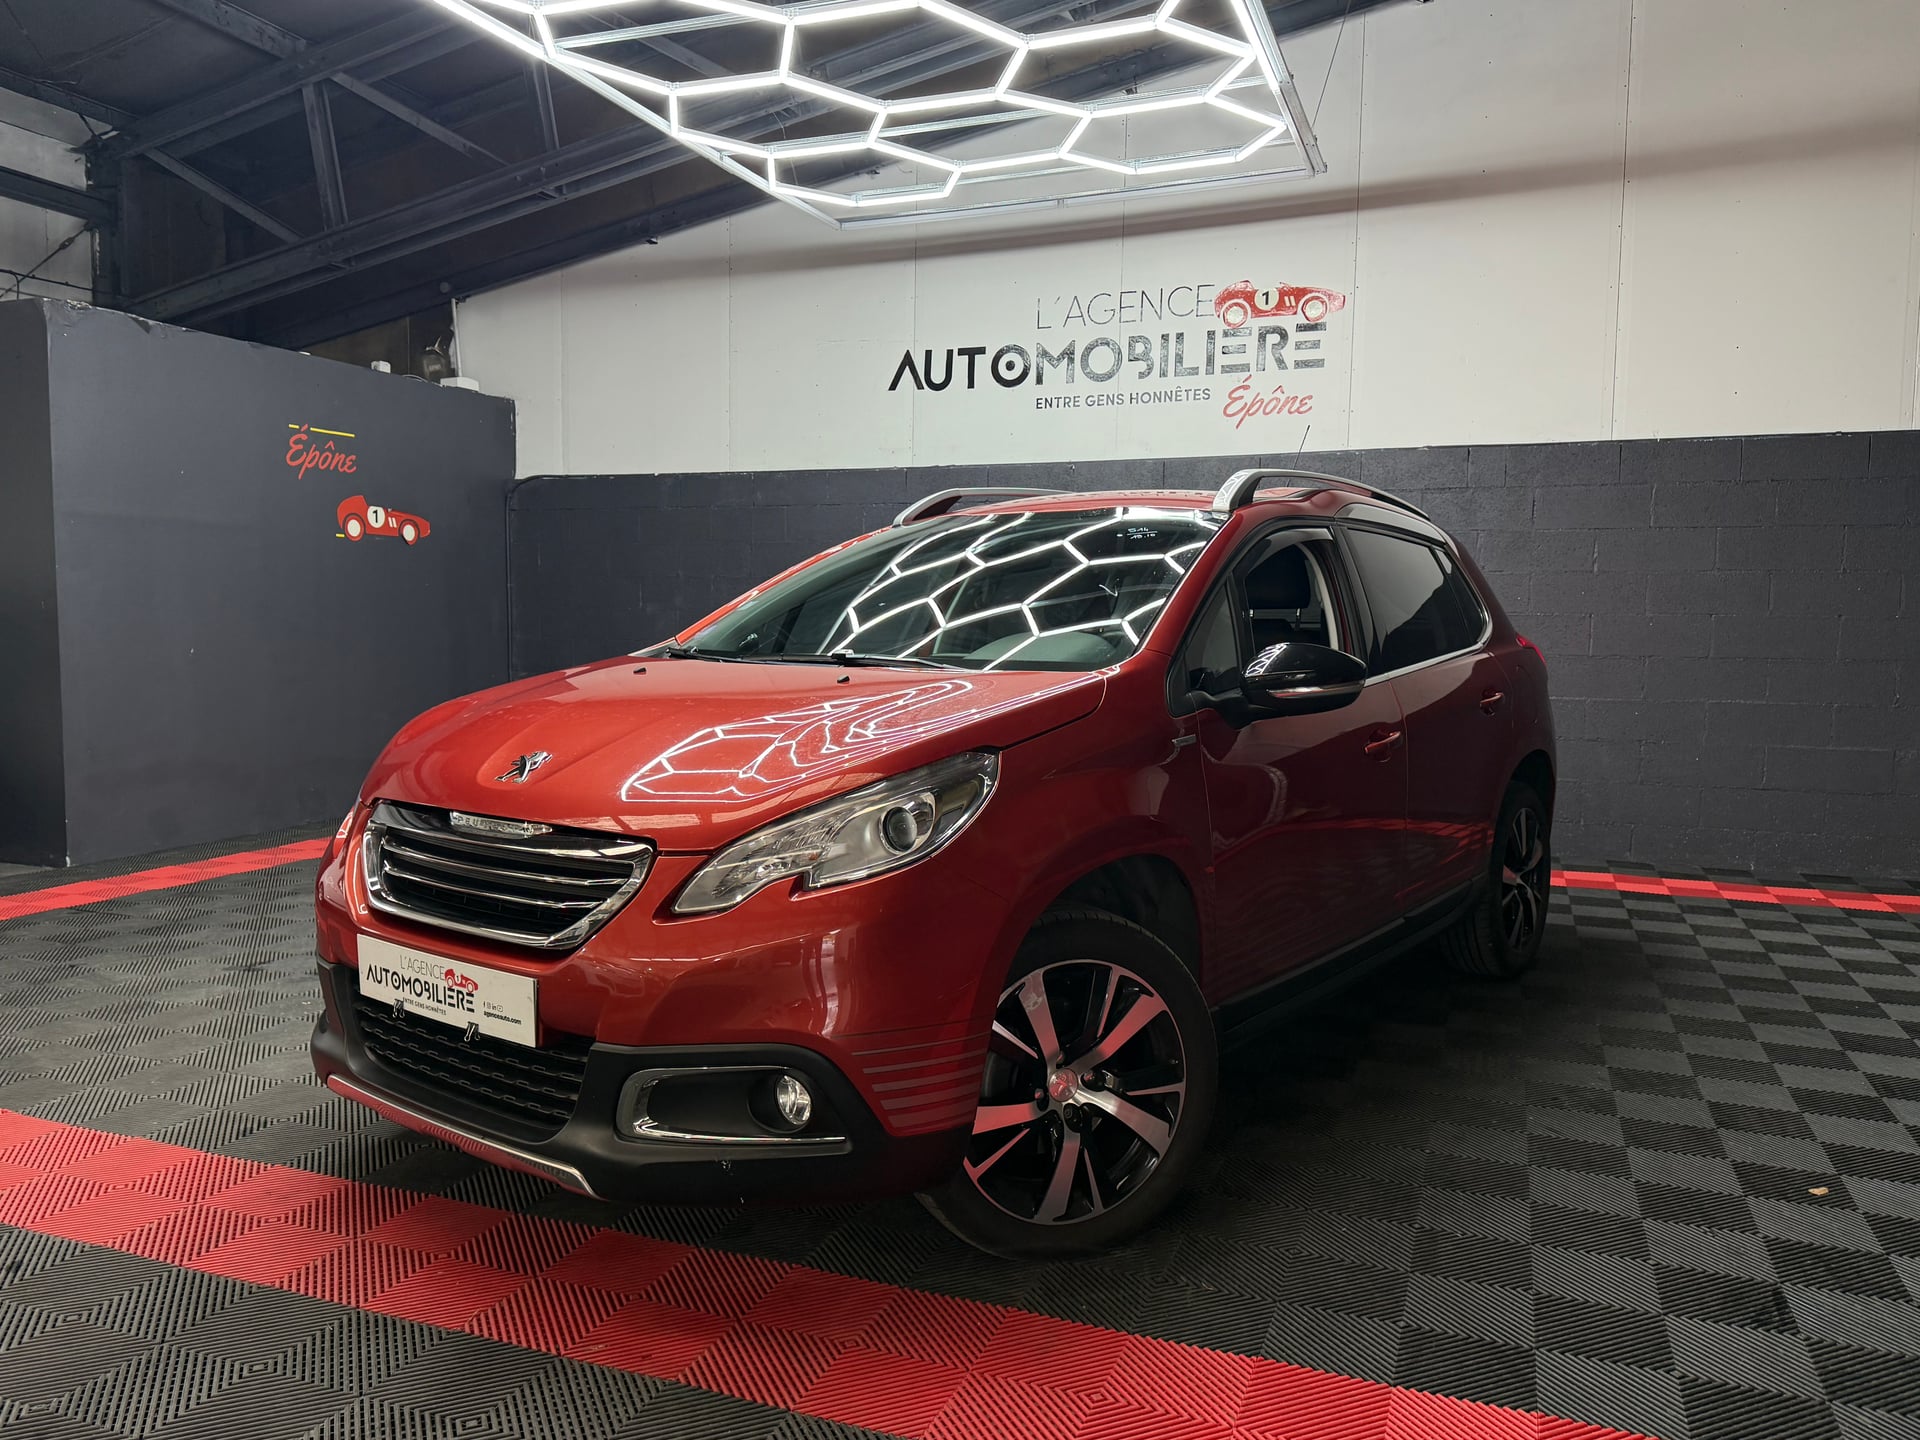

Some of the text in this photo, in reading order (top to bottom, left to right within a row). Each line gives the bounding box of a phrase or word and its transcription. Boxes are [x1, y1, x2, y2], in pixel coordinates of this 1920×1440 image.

[1261, 290, 1270, 306] 1
[1035, 386, 1211, 410] ENTRE GENS HONNÊTES
[1221, 375, 1313, 429] Épône
[285, 423, 357, 480] Épône
[372, 509, 378, 523] 1
